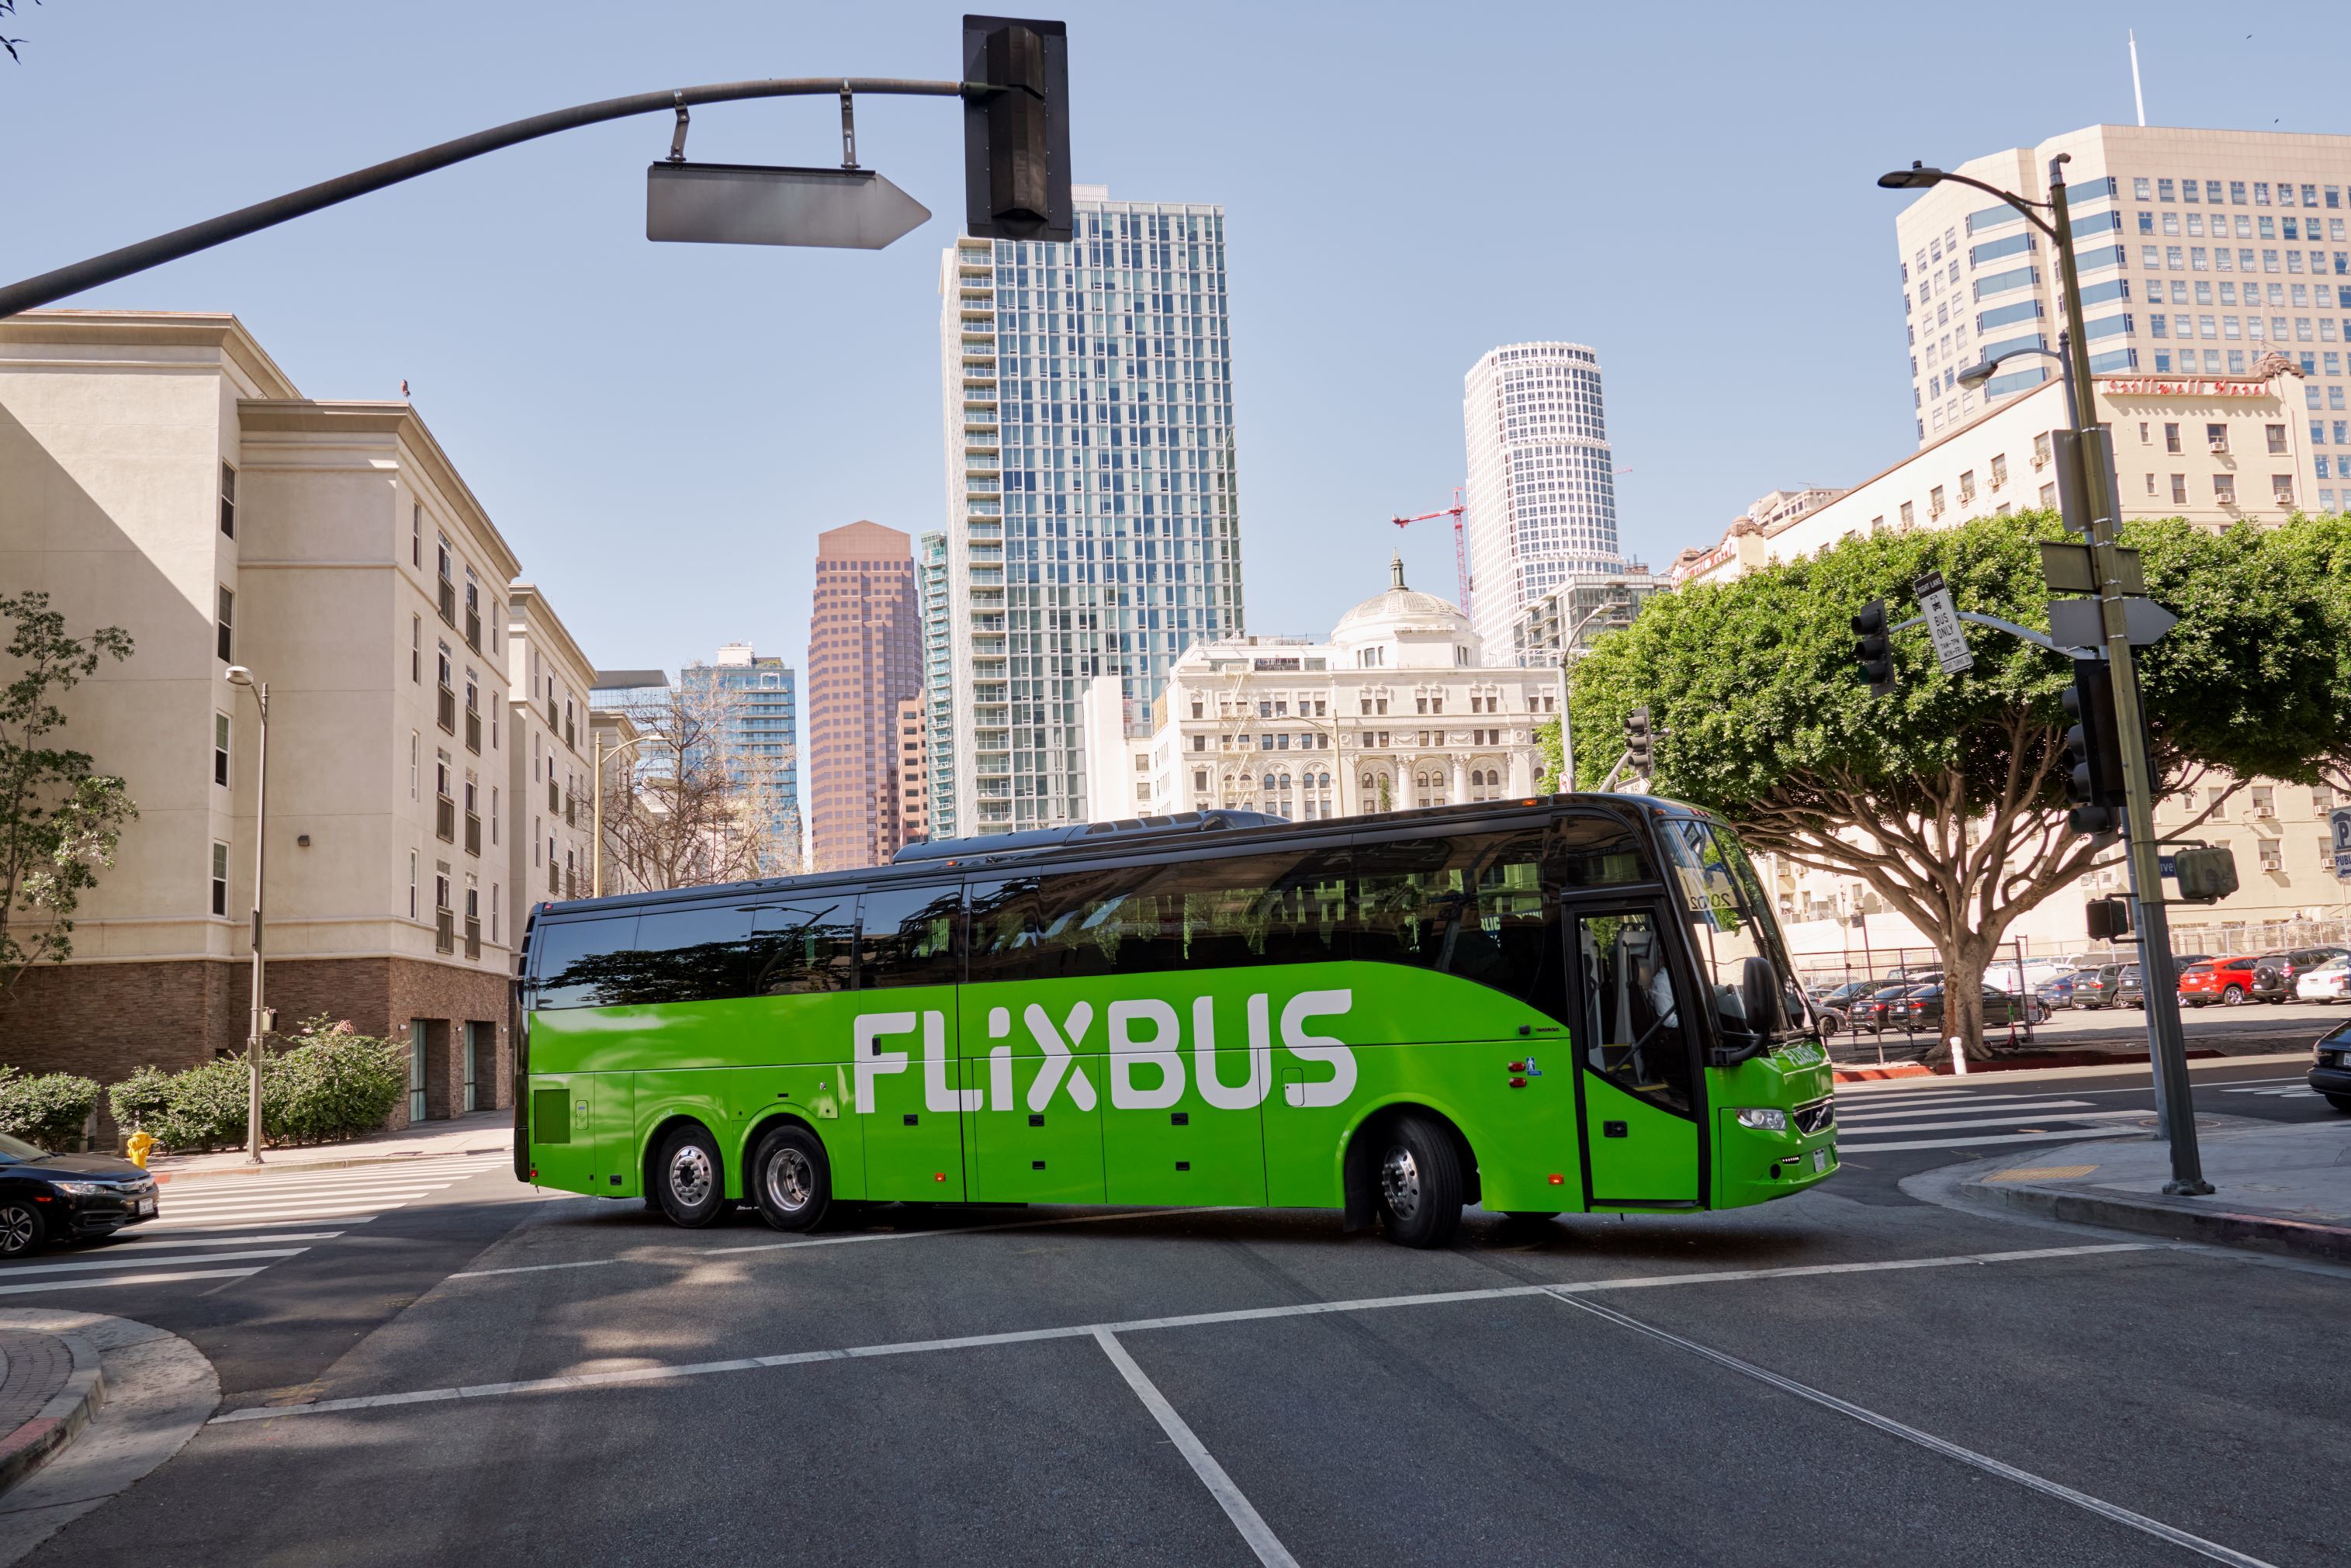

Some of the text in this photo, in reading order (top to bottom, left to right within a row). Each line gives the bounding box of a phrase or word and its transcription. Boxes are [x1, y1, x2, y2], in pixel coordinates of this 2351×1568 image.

[2107, 378, 2270, 396] Stillwell Hotel
[1917, 578, 1942, 594] RIGHT LANE
[1934, 612, 1949, 627] BUS
[1937, 623, 1954, 639] ONLY
[2159, 863, 2173, 872] ive
[2335, 854, 2351, 866] PUBL
